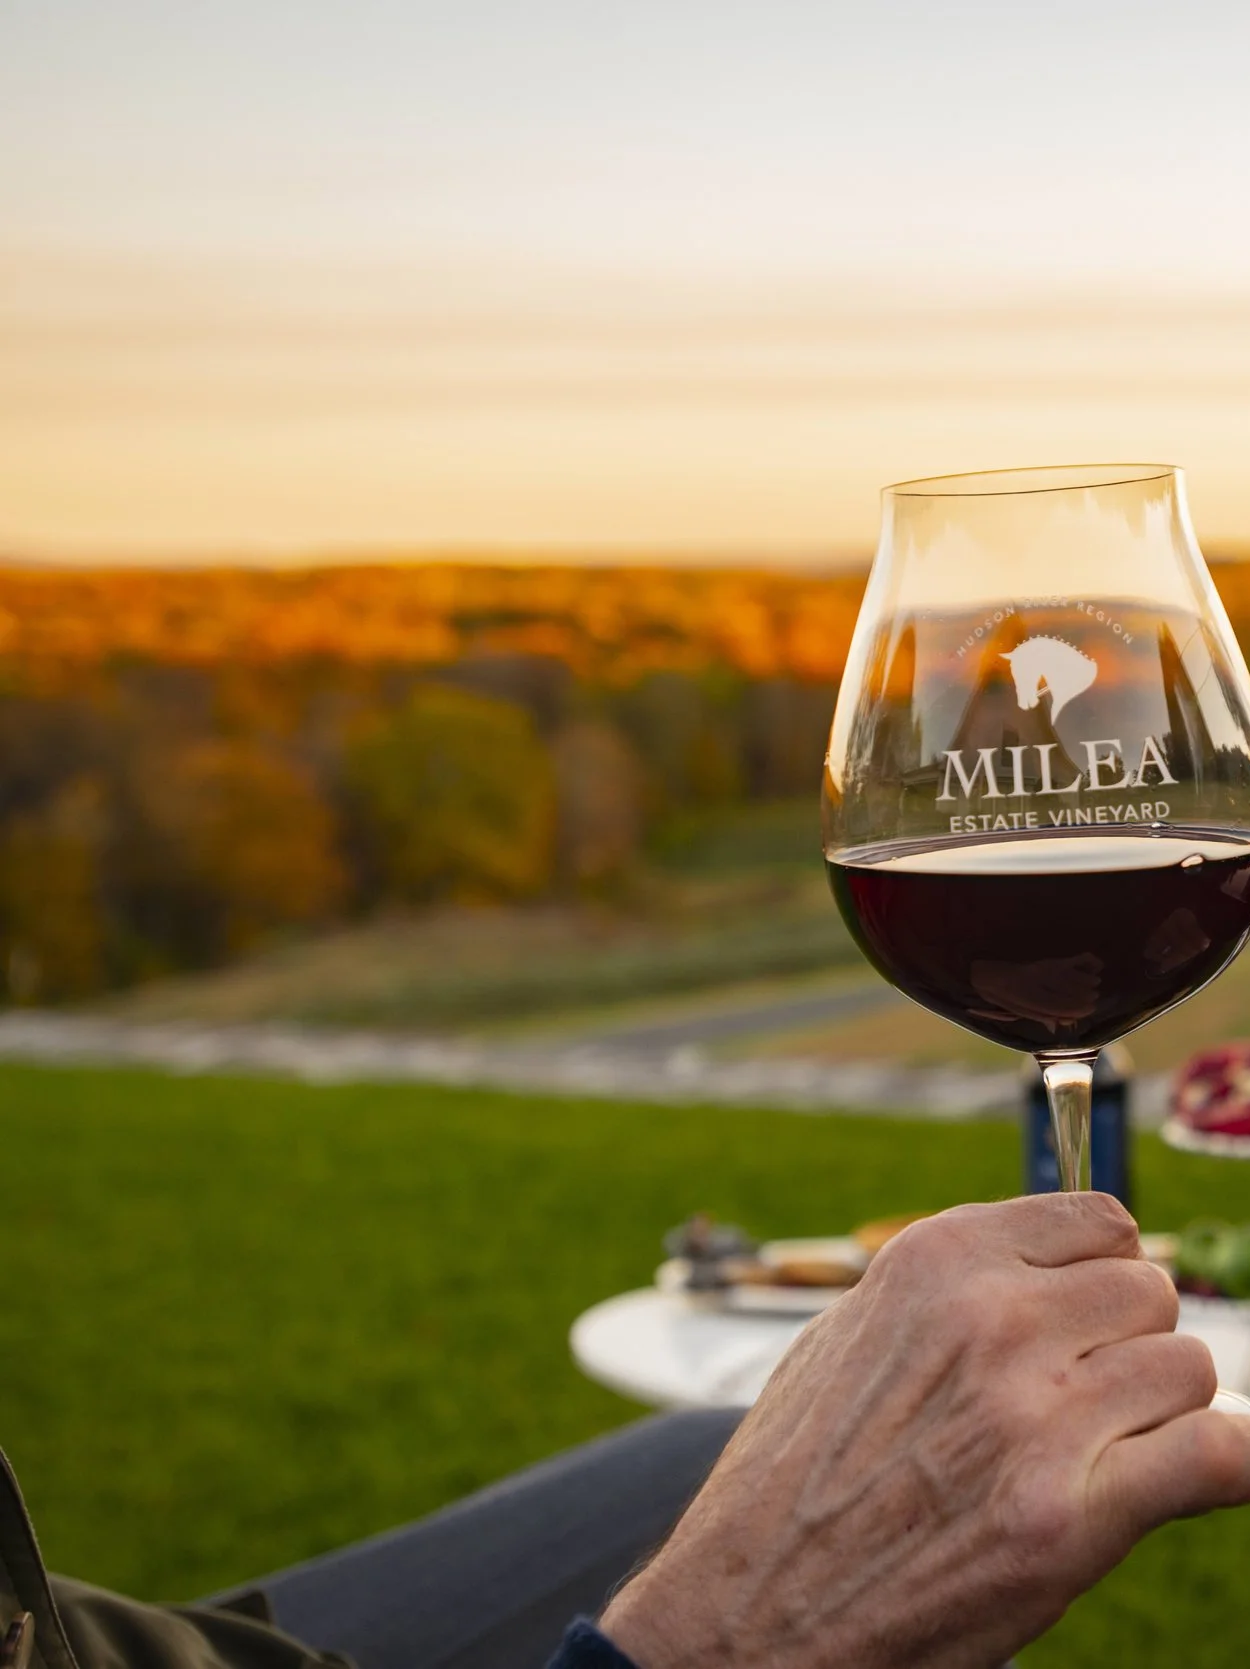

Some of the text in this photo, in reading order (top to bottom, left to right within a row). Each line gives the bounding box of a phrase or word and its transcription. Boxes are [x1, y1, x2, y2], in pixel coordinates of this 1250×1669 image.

[957, 606, 1015, 658] HUDSON
[1076, 601, 1133, 645] REGION
[935, 736, 1179, 801] MILEA
[950, 801, 1170, 833] ESTATE VINEYARD
